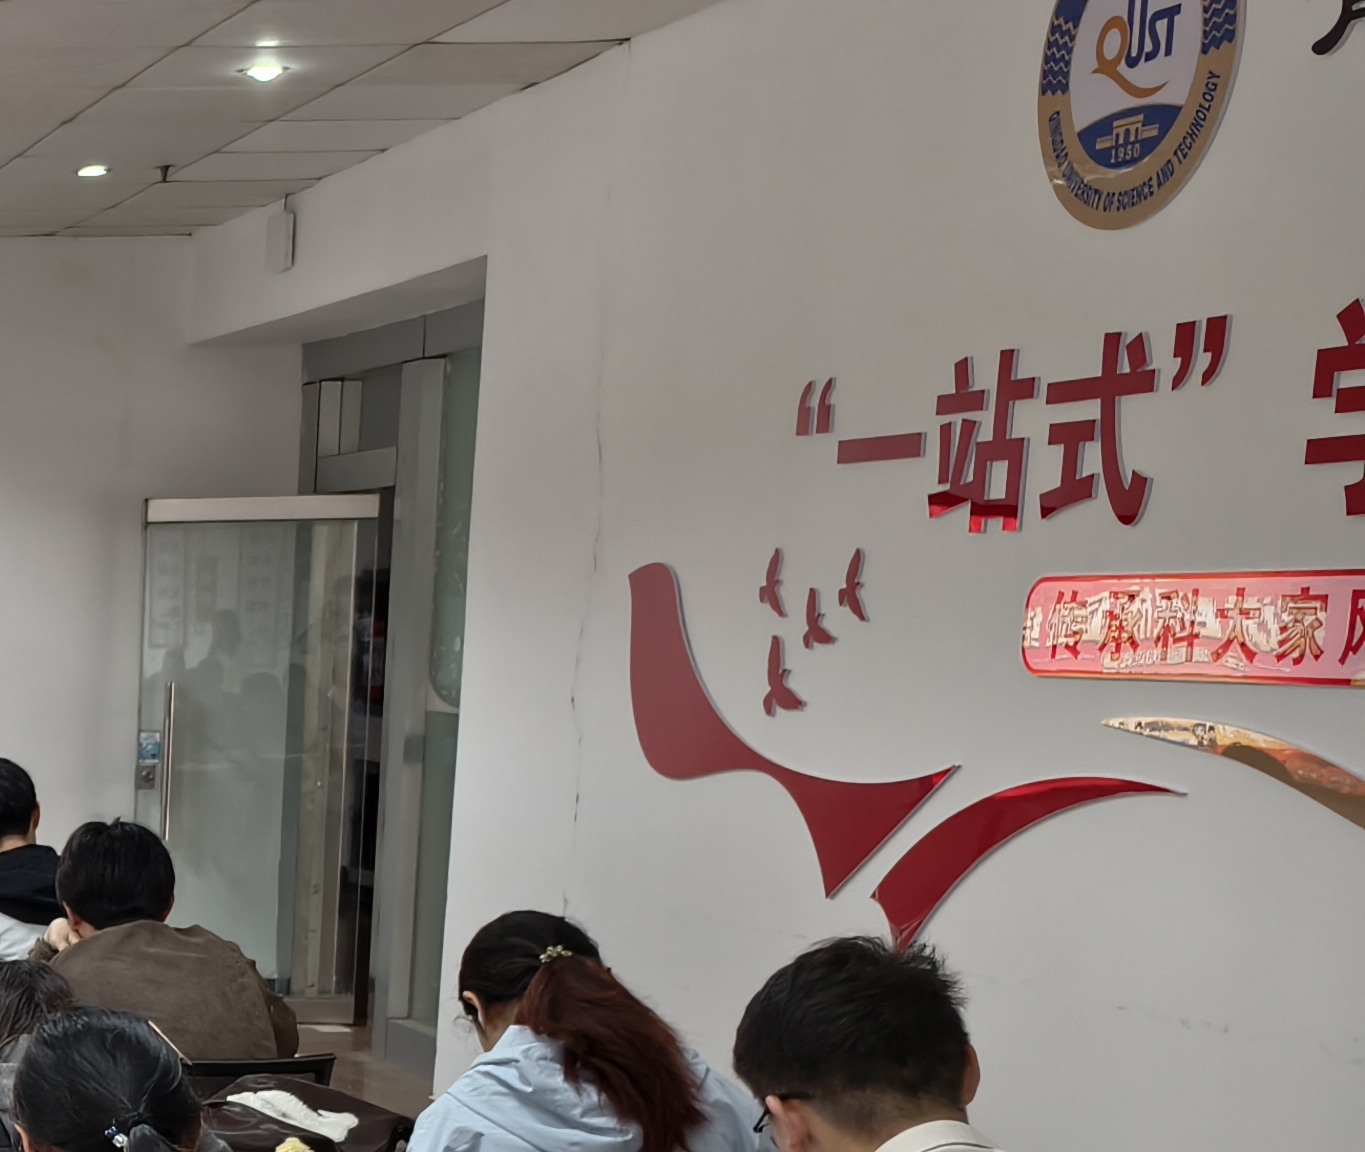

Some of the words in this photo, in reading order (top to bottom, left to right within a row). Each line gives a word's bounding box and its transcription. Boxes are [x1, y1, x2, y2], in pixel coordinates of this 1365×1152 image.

[1091, 0, 1182, 98] QUST
[1103, 192, 1117, 212] OF
[1116, 176, 1156, 212] SCIENCE
[1156, 159, 1175, 191] AND
[1173, 70, 1221, 166] TECHNOLOGY
[1110, 143, 1140, 163] 1950
